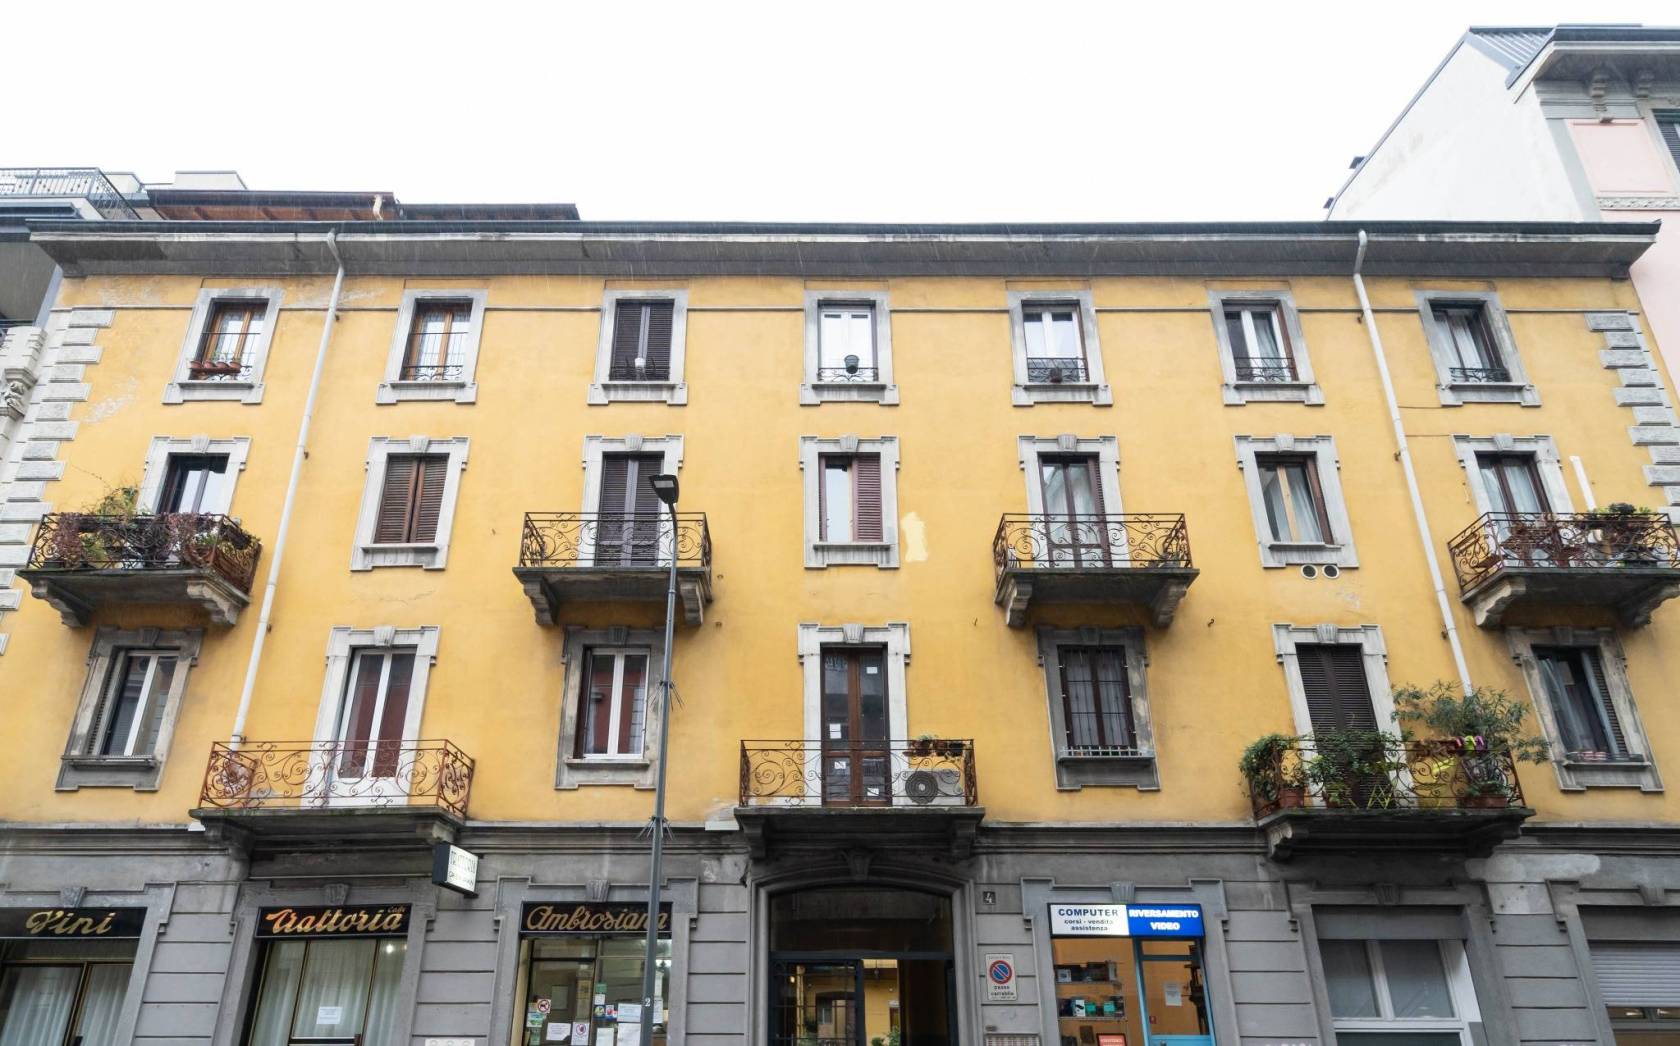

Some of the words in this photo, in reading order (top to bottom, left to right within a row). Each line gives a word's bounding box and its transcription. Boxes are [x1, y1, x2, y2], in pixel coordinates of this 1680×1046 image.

[1058, 908, 1119, 917] COMPUTER
[1129, 909, 1200, 918] RIVERSAMENTO
[26, 910, 117, 935] Vini
[265, 908, 403, 935] Trattoria
[1150, 922, 1181, 931] VIDEO
